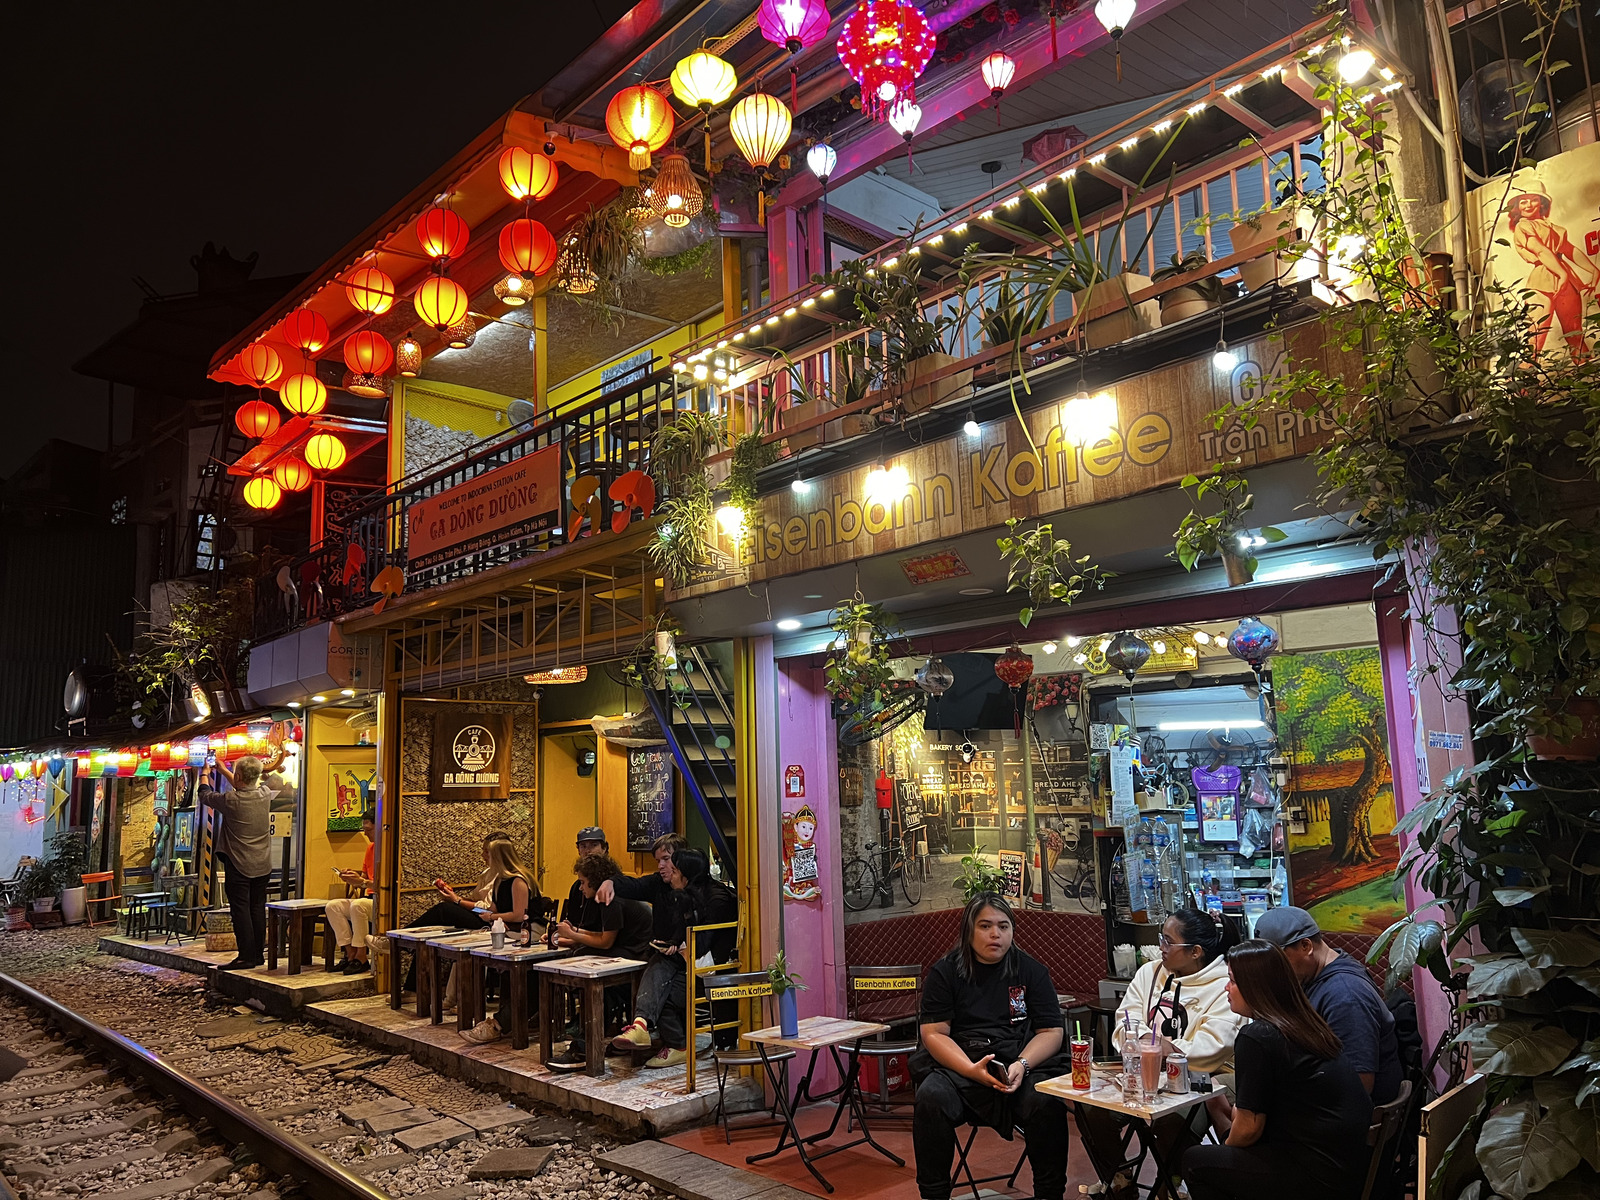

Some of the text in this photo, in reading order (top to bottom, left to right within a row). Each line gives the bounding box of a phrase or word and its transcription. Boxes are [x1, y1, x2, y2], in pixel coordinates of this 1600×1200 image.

[1199, 417, 1269, 461] Trần
[969, 411, 1173, 510] Kaffee
[327, 646, 369, 656] COREST
[444, 773, 454, 784] GA
[854, 979, 915, 988] Eisenbahn Kaffee
[711, 988, 748, 999] Eisenbahn
